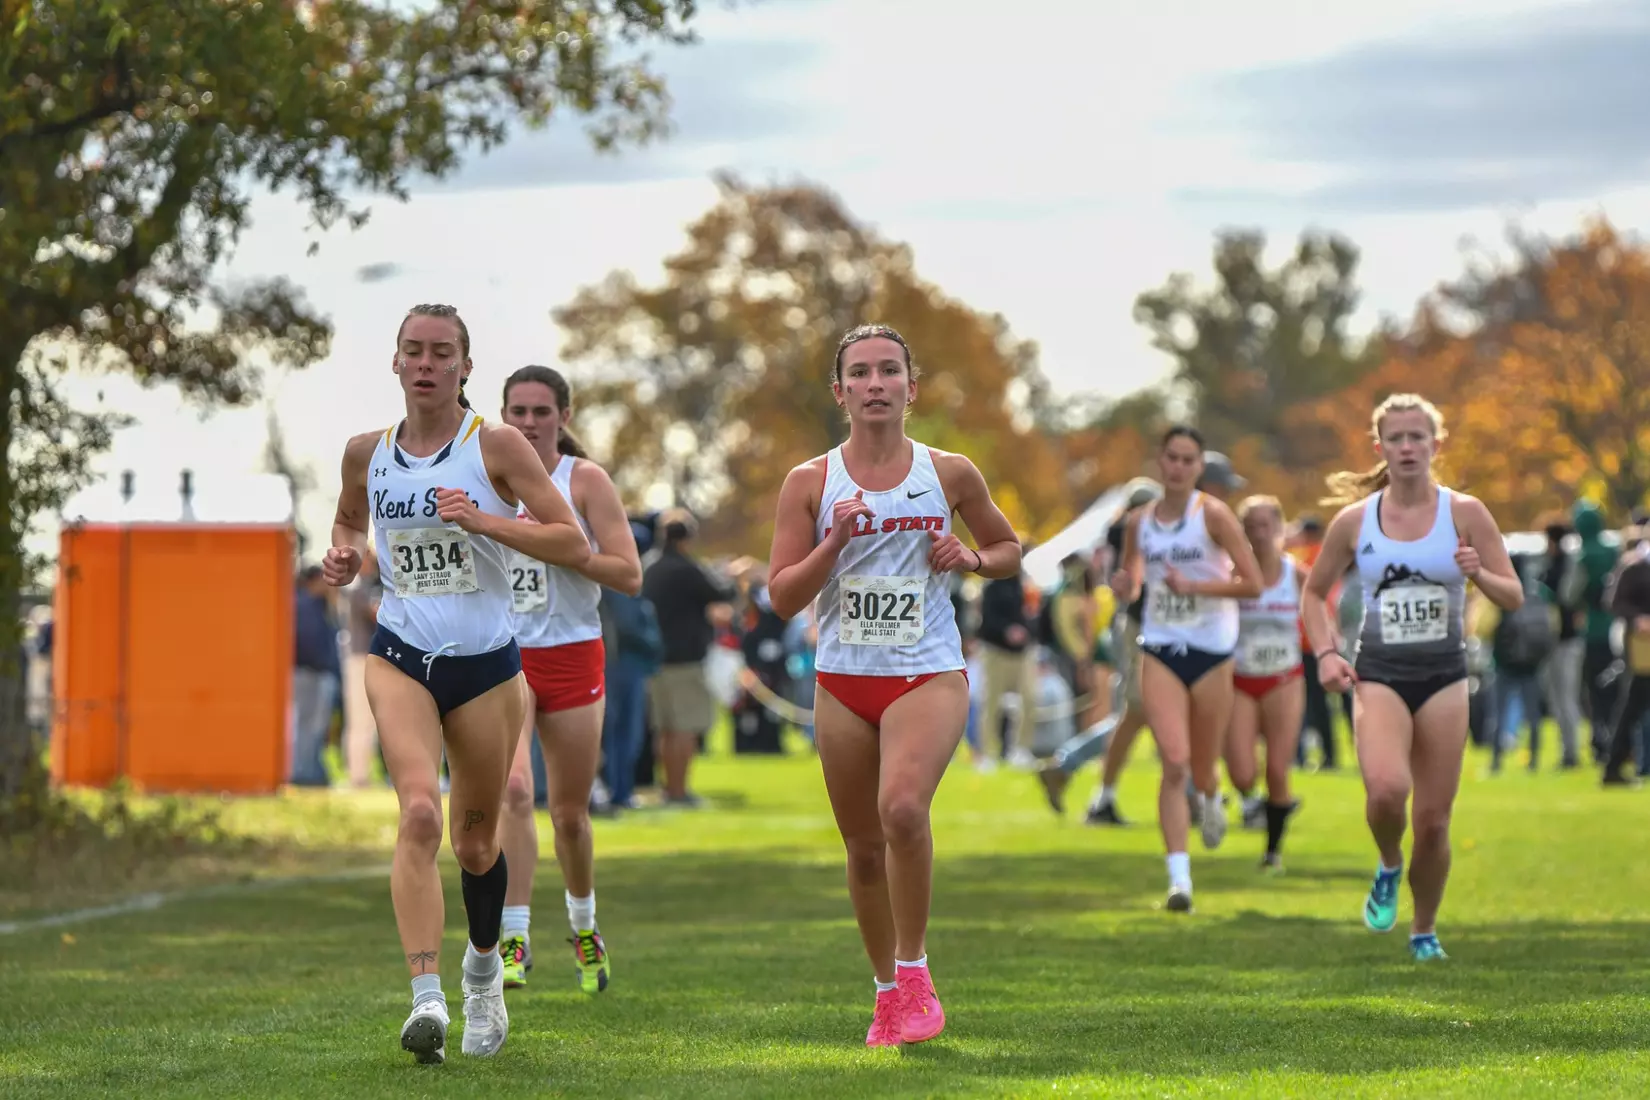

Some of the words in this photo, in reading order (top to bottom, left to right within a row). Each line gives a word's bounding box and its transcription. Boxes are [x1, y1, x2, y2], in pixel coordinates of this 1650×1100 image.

[373, 489, 416, 520] Kent
[825, 519, 878, 538] LL
[880, 516, 945, 534] STATE
[398, 541, 465, 573] 3134
[429, 571, 452, 579] STRAUB
[432, 579, 450, 587] STATE
[847, 591, 916, 621] 3022
[875, 621, 901, 629] FULLMER
[863, 629, 878, 637] BALL
[879, 629, 897, 637] STATE
